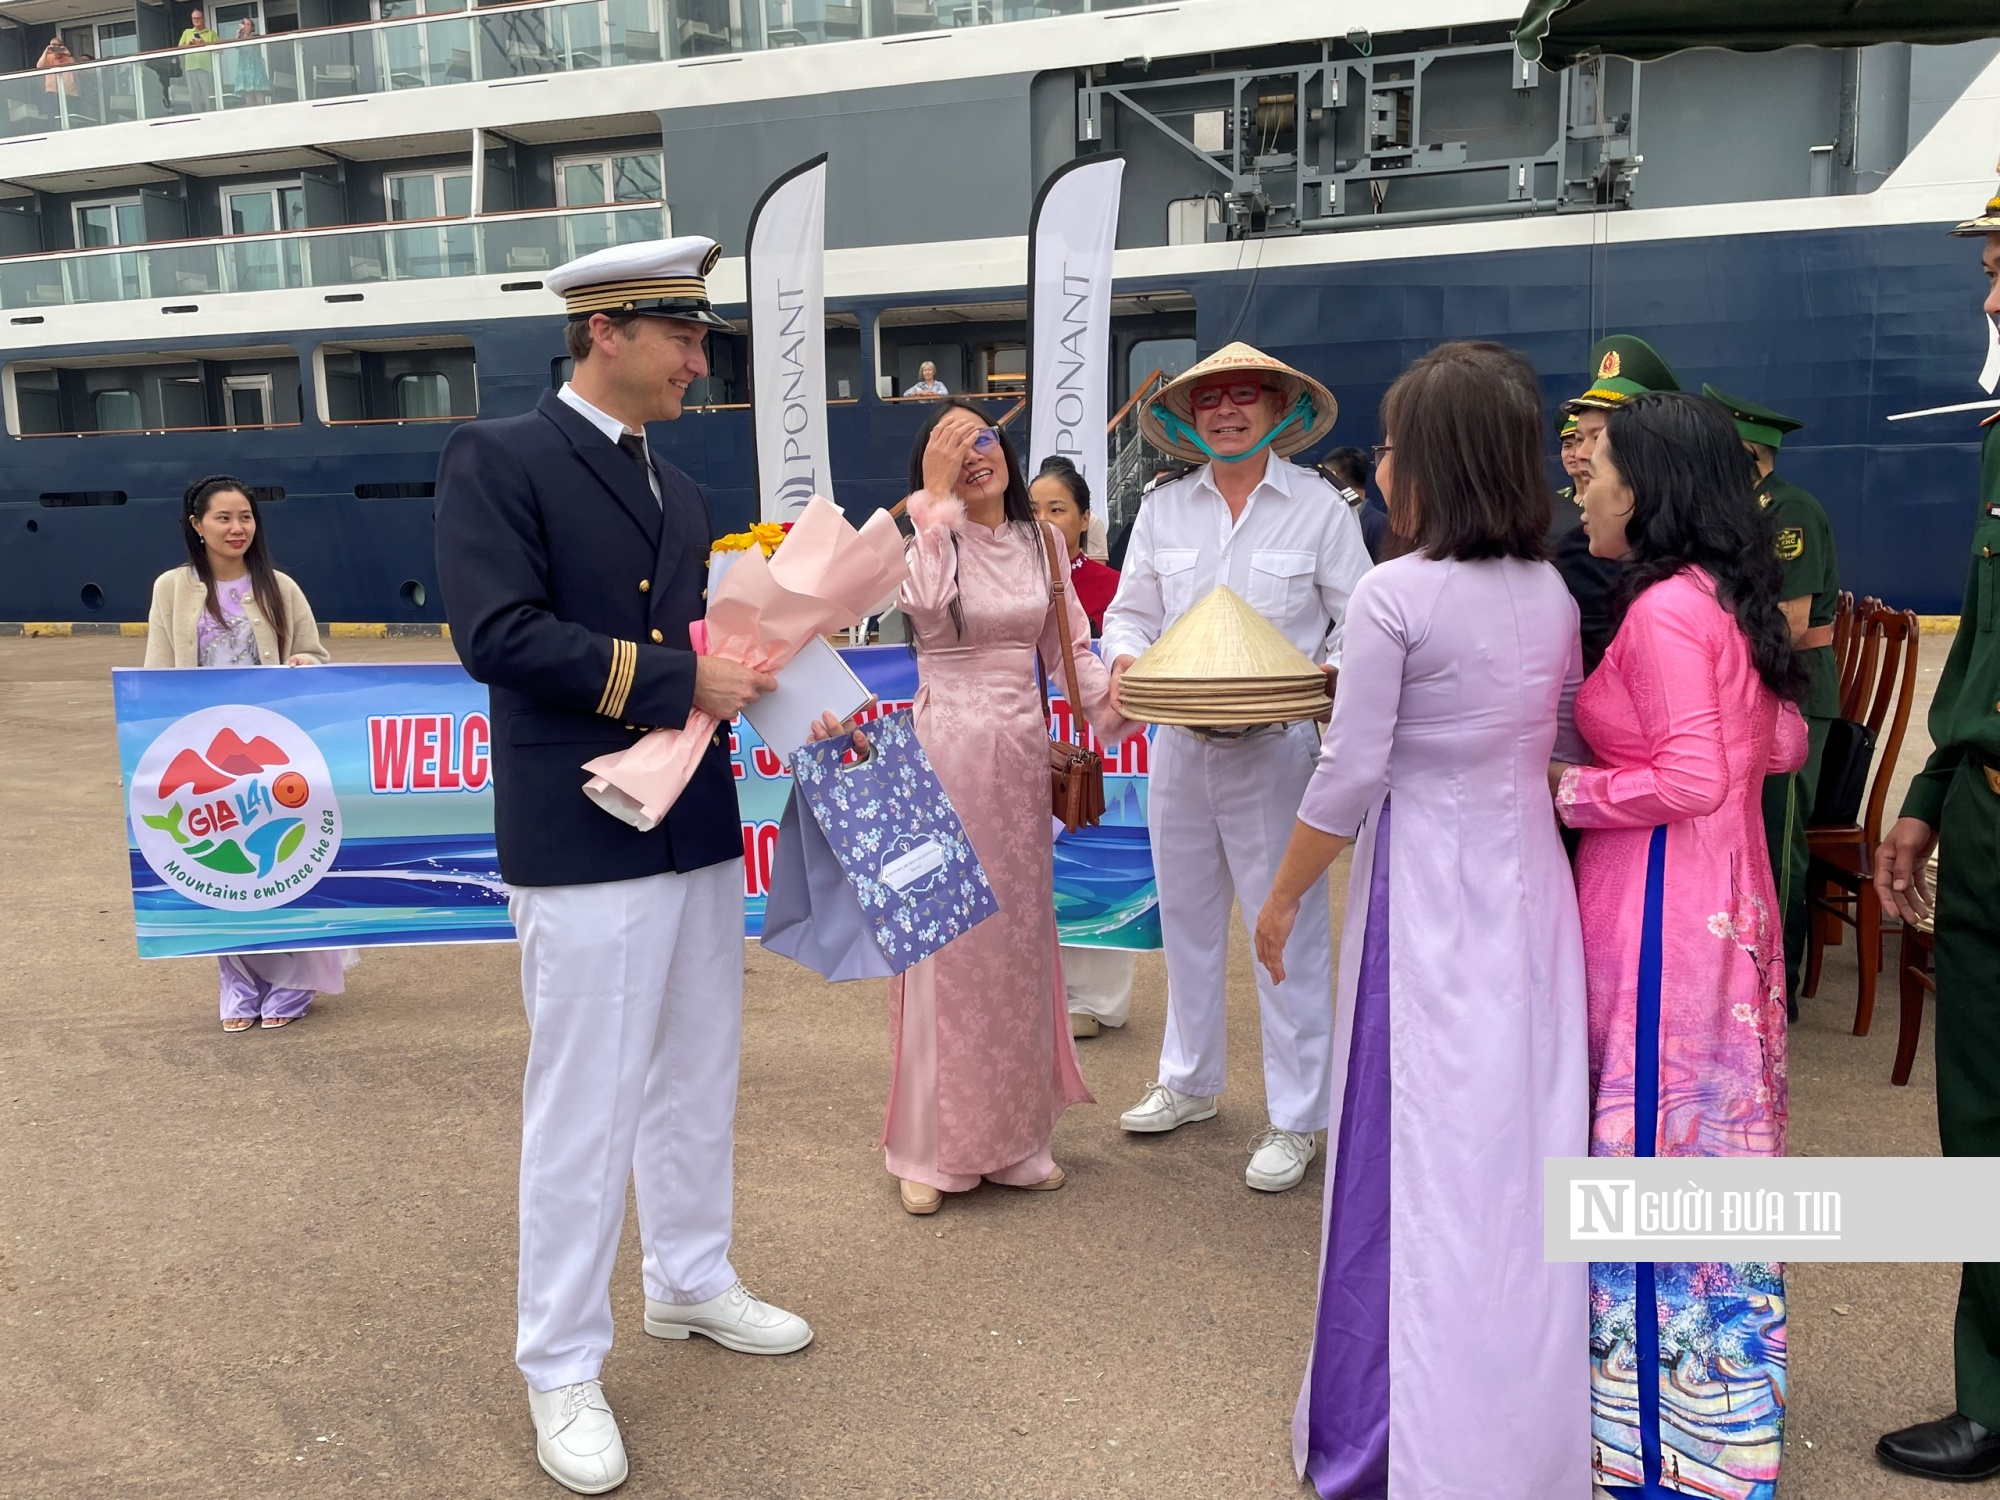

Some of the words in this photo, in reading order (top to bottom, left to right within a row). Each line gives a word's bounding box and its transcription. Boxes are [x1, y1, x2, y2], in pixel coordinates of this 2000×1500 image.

[777, 278, 811, 464] PONANT
[1055, 261, 1090, 456] PONANT
[370, 714, 490, 790] WELC
[187, 799, 240, 837] GIA
[234, 778, 273, 826] LAI
[320, 809, 334, 835] sea
[310, 837, 331, 863] the
[163, 860, 248, 901] Mountains
[253, 863, 314, 900] embrace
